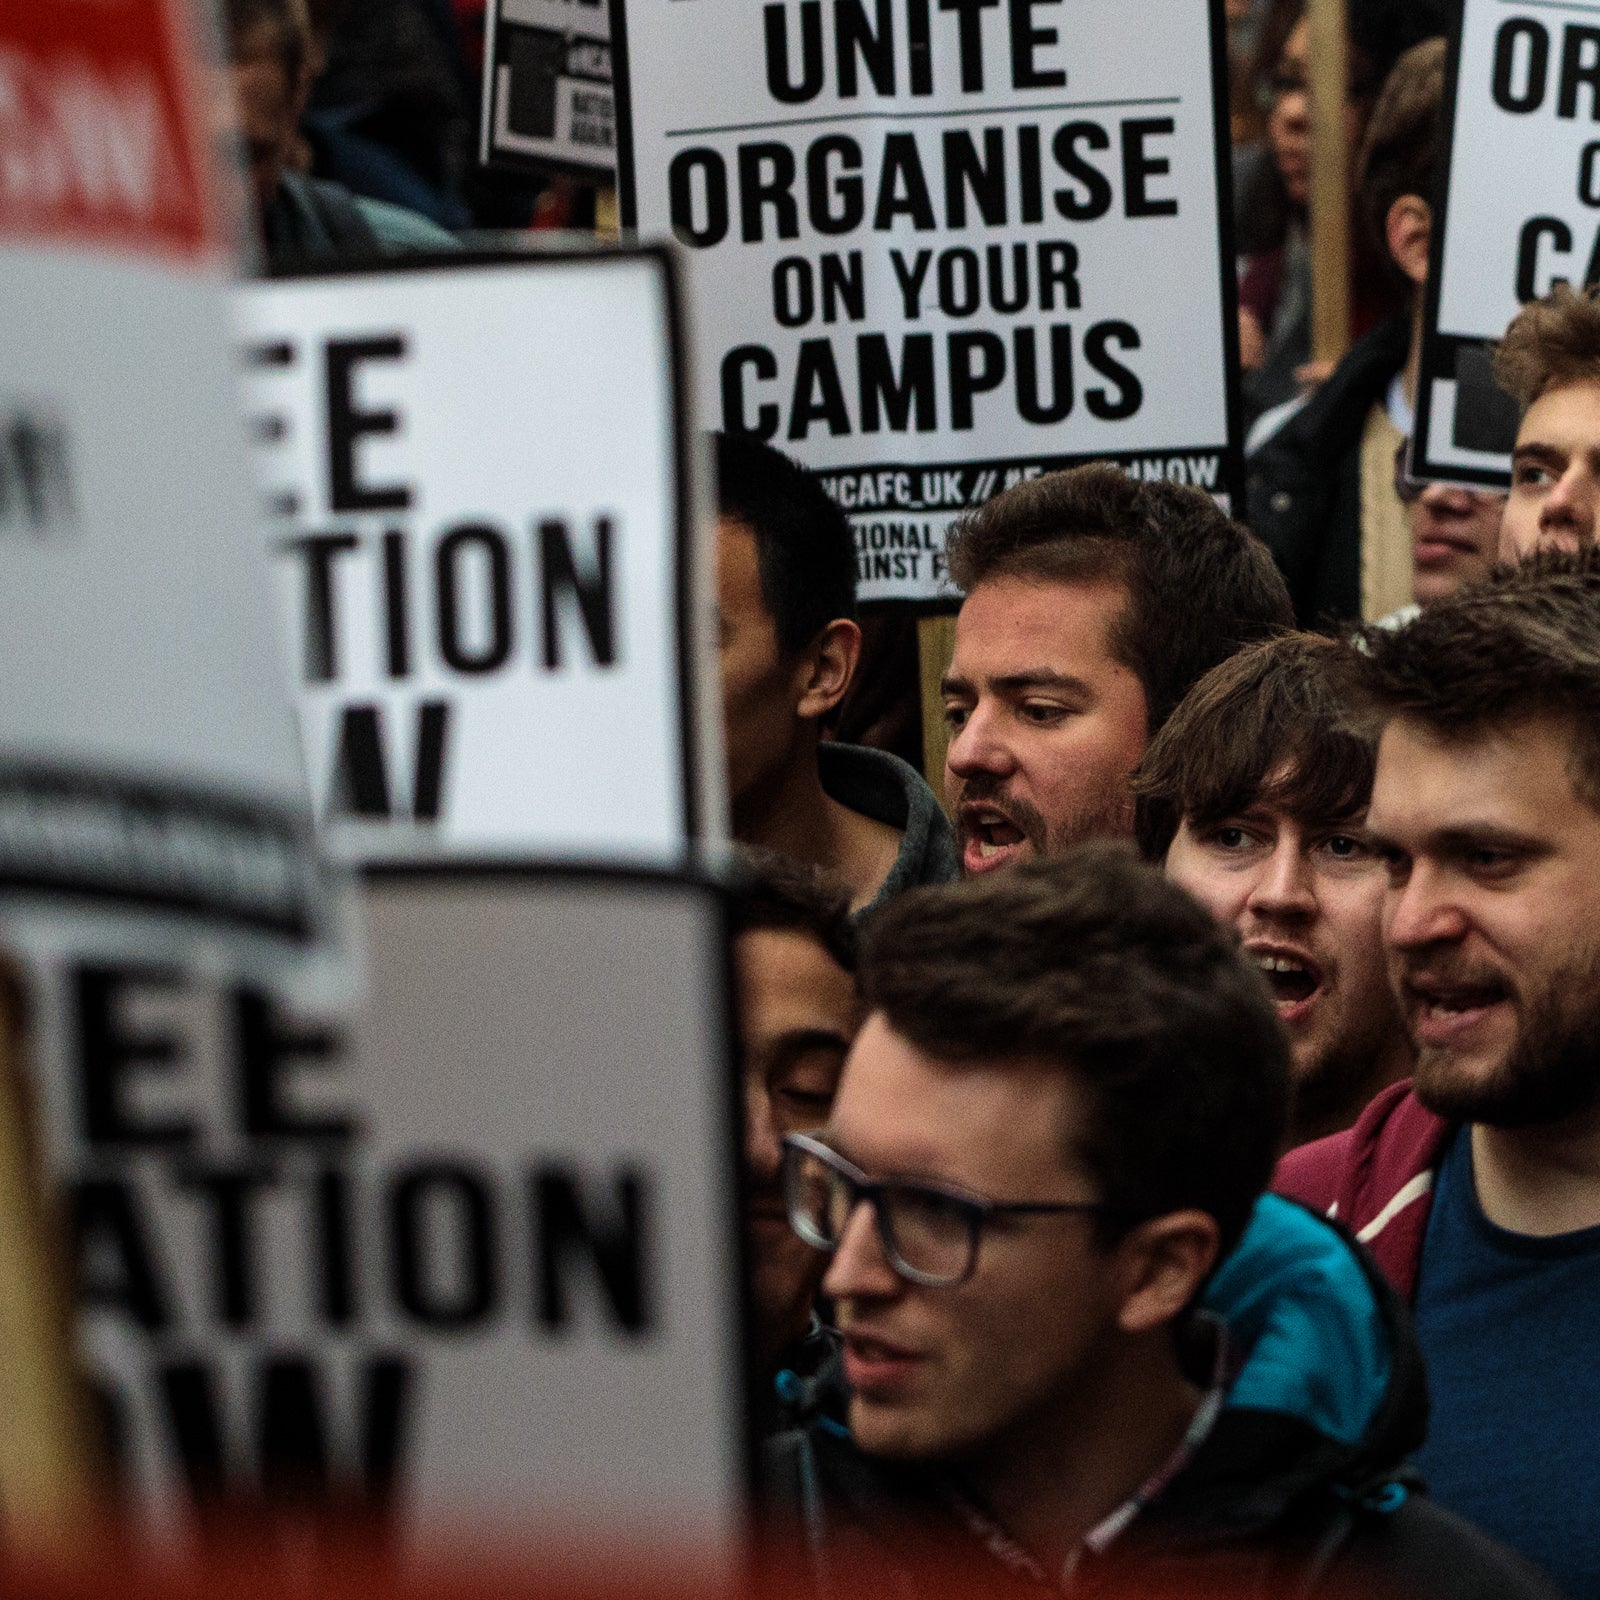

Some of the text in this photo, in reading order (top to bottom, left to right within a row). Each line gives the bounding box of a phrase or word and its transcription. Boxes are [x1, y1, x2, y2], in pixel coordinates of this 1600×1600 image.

[667, 117, 1179, 250] ORGANISE
[772, 240, 1081, 329] ON YOUR
[719, 319, 1144, 444] CAMPUS
[821, 468, 965, 510] NCAFC_UK
